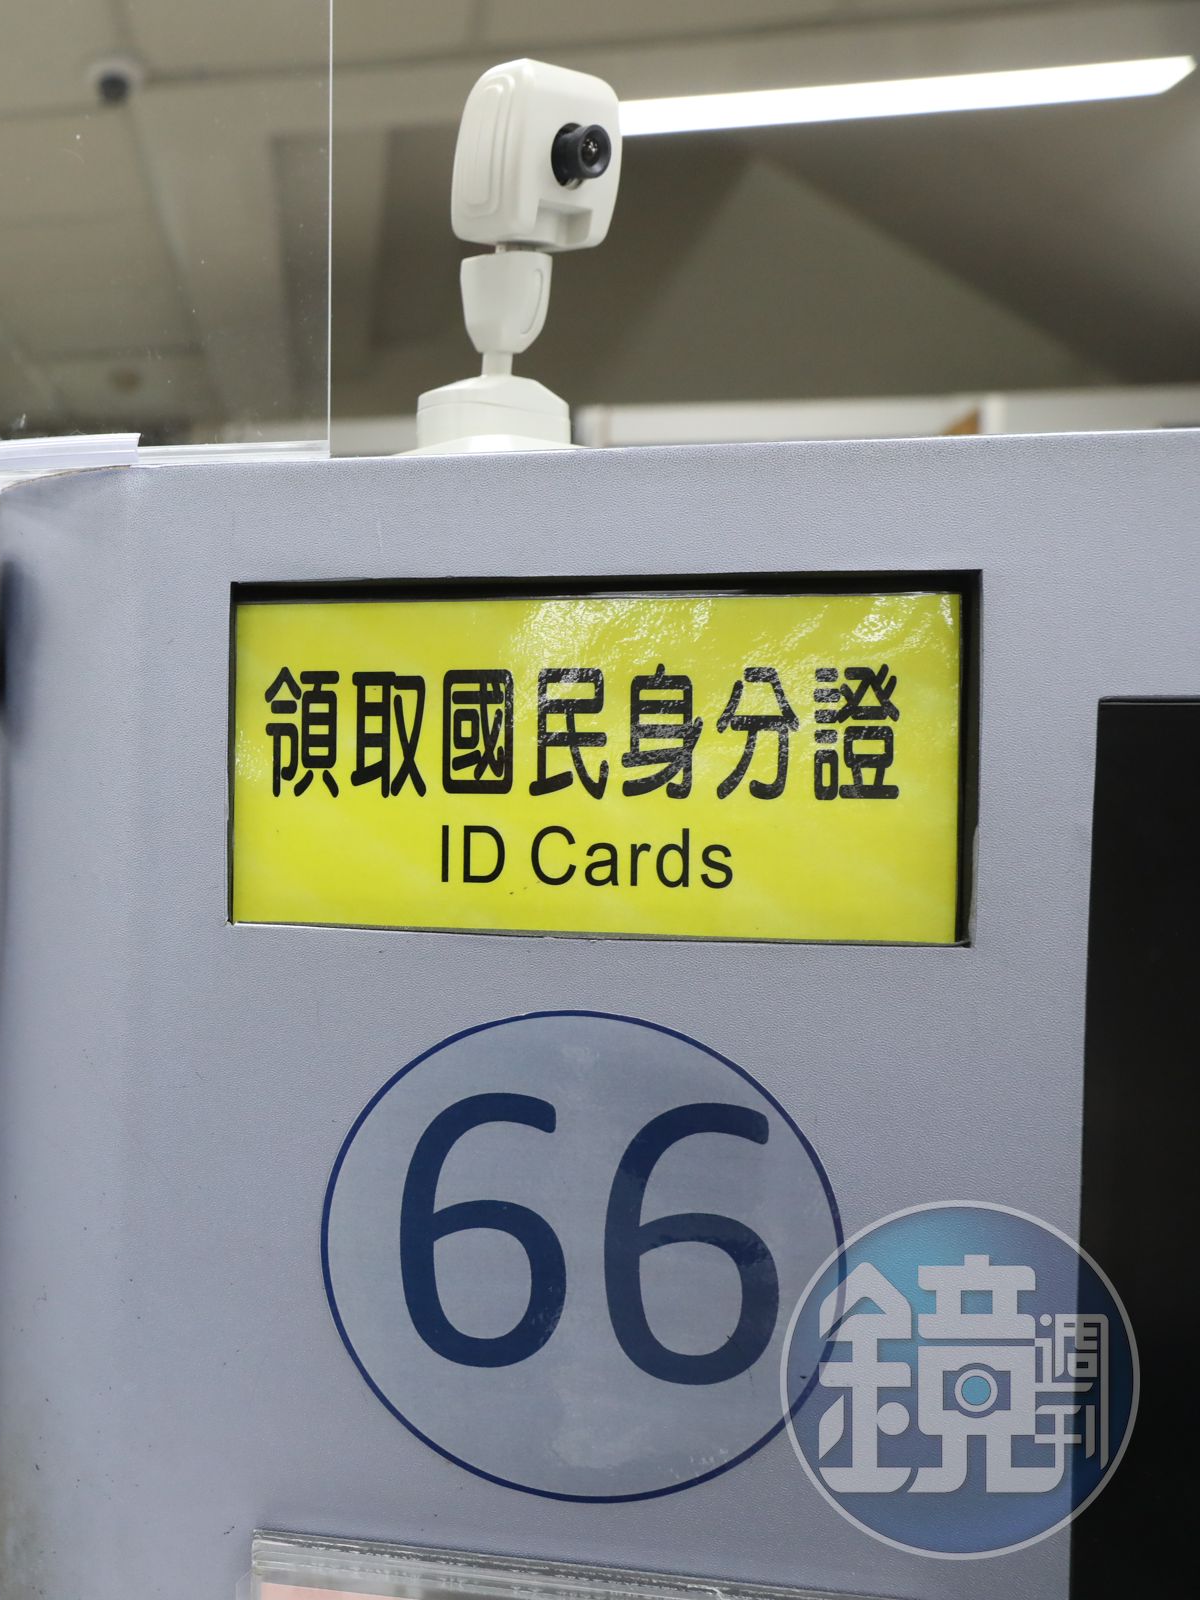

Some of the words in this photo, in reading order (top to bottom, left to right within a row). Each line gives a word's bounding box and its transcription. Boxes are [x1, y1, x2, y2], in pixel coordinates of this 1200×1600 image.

[264, 663, 899, 801] 領取國民身分證
[441, 824, 506, 884] ID
[530, 826, 734, 889] Cards
[399, 1091, 780, 1386] 66
